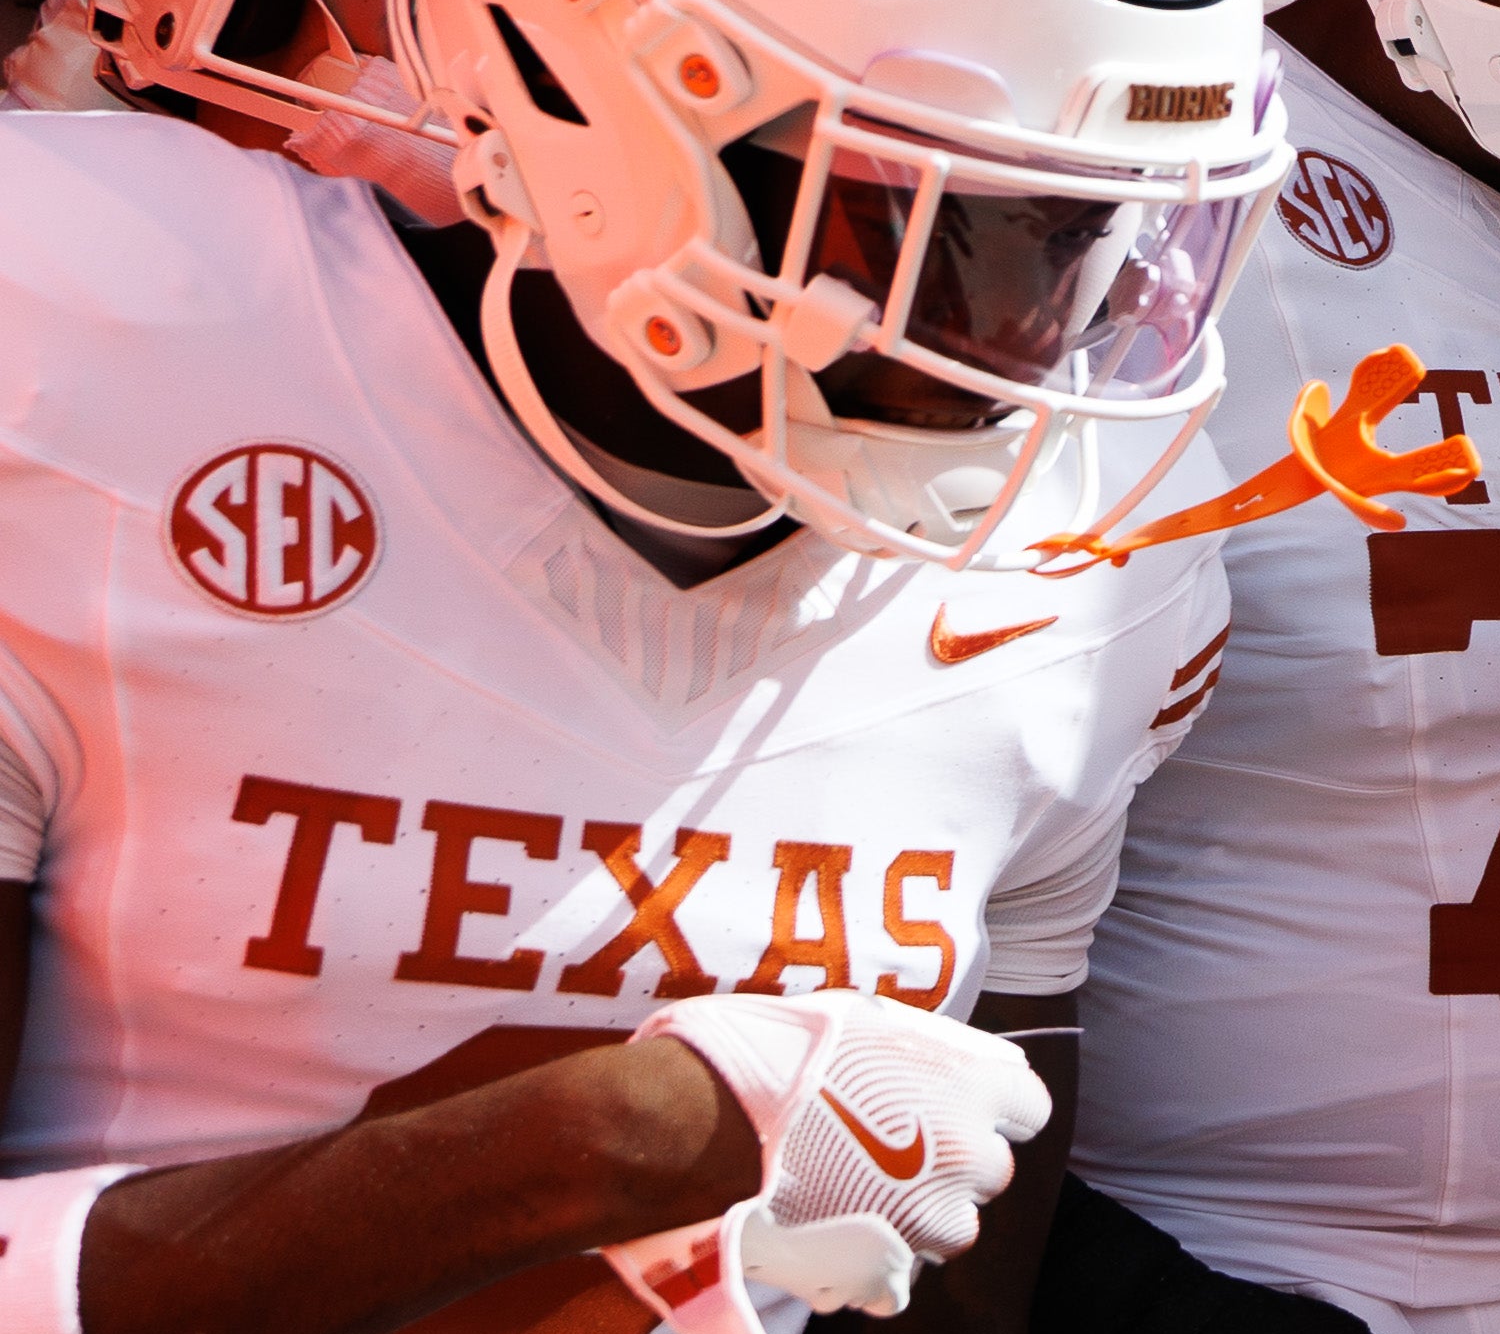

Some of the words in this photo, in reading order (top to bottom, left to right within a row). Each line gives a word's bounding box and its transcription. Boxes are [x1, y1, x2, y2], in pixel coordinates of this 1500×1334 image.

[1126, 82, 1235, 122] HORNS
[1280, 156, 1385, 259] SEC
[183, 451, 364, 608] SEC
[231, 774, 957, 1013] TEXAS
